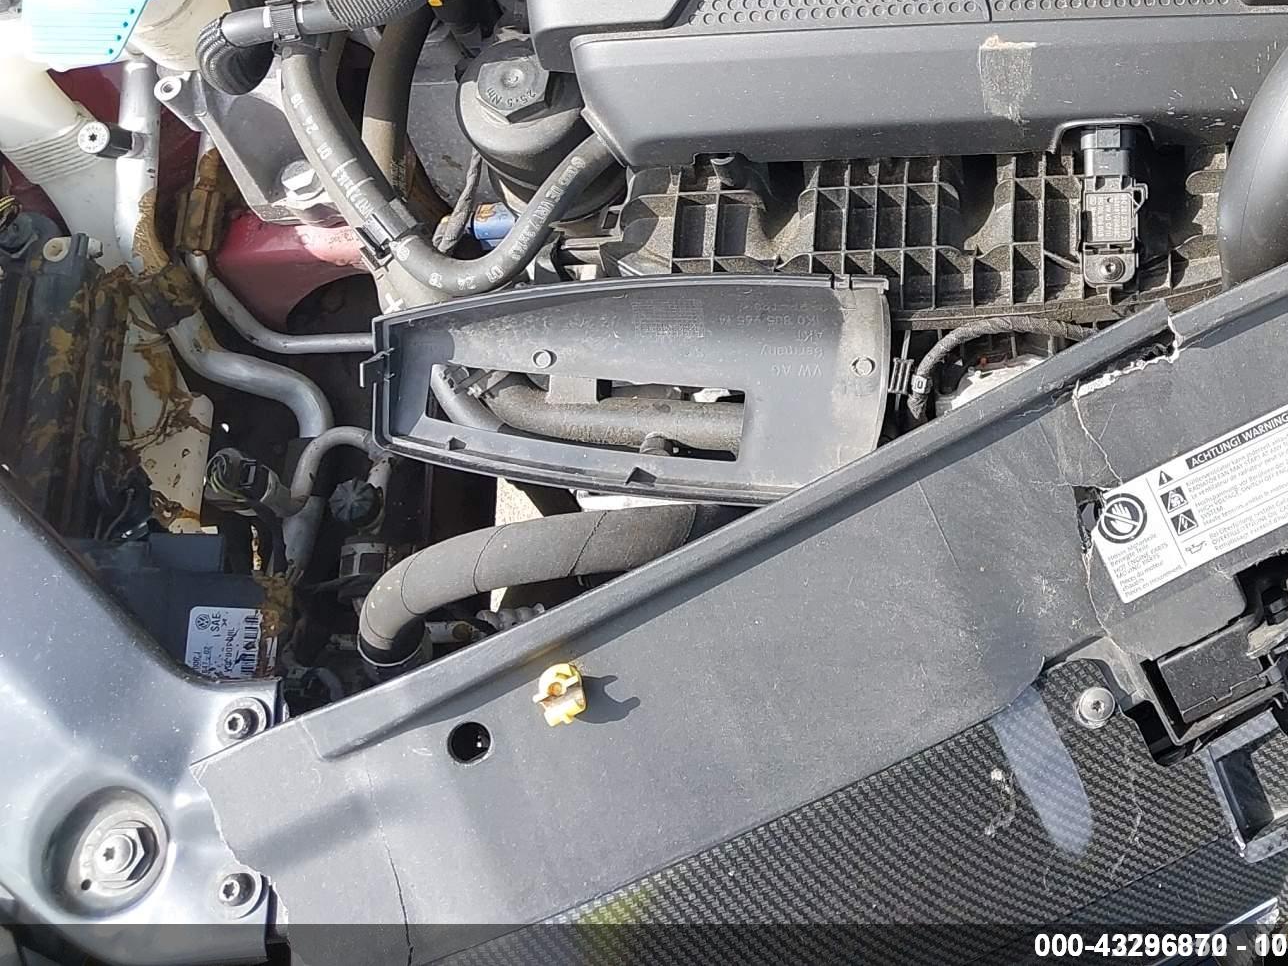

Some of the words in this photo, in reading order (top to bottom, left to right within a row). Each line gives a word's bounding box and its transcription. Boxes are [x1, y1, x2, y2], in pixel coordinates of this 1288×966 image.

[759, 344, 825, 360] Germany
[797, 364, 823, 377] VW
[1189, 434, 1242, 467] ACHTUNG!
[209, 611, 221, 632] SAE
